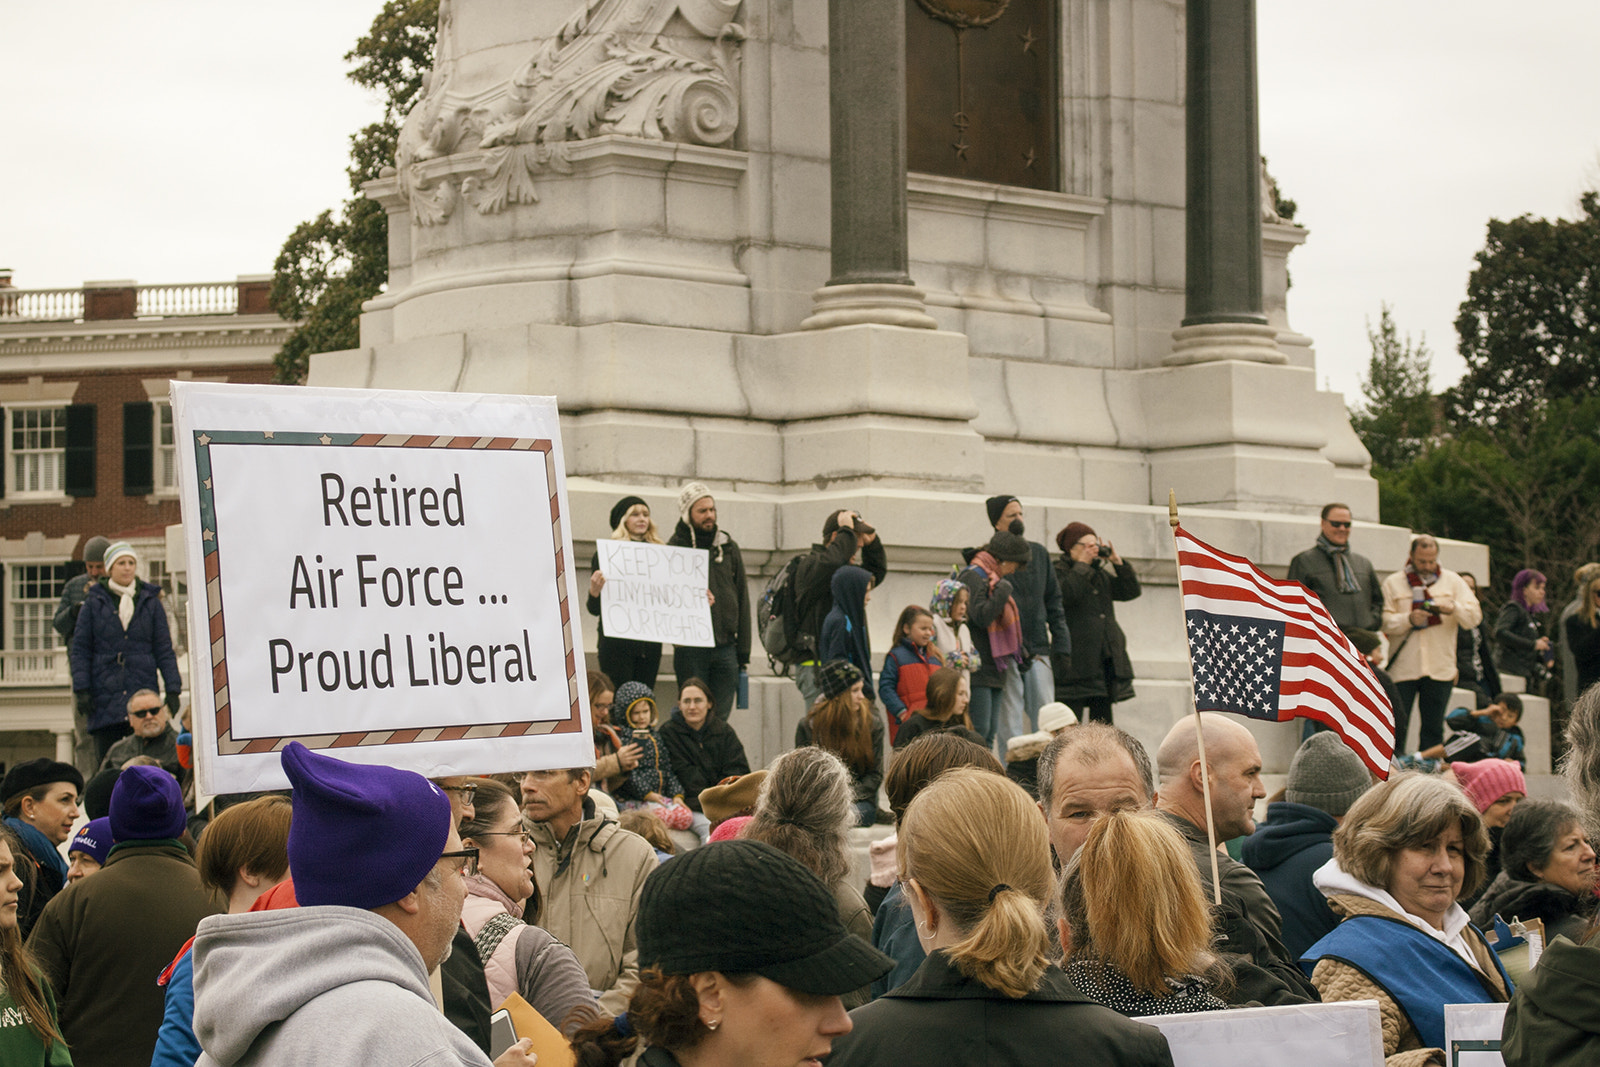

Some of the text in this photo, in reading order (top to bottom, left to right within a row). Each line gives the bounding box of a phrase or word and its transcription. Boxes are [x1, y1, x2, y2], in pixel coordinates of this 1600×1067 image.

[320, 472, 466, 527] Retired
[289, 554, 344, 610] Air
[356, 554, 465, 609] Force
[605, 543, 706, 580] KEEP YOUR
[605, 578, 706, 609] TINY HANDS OFF
[607, 603, 712, 642] OUR RIGHTS
[268, 629, 537, 694] Proud Liberal
